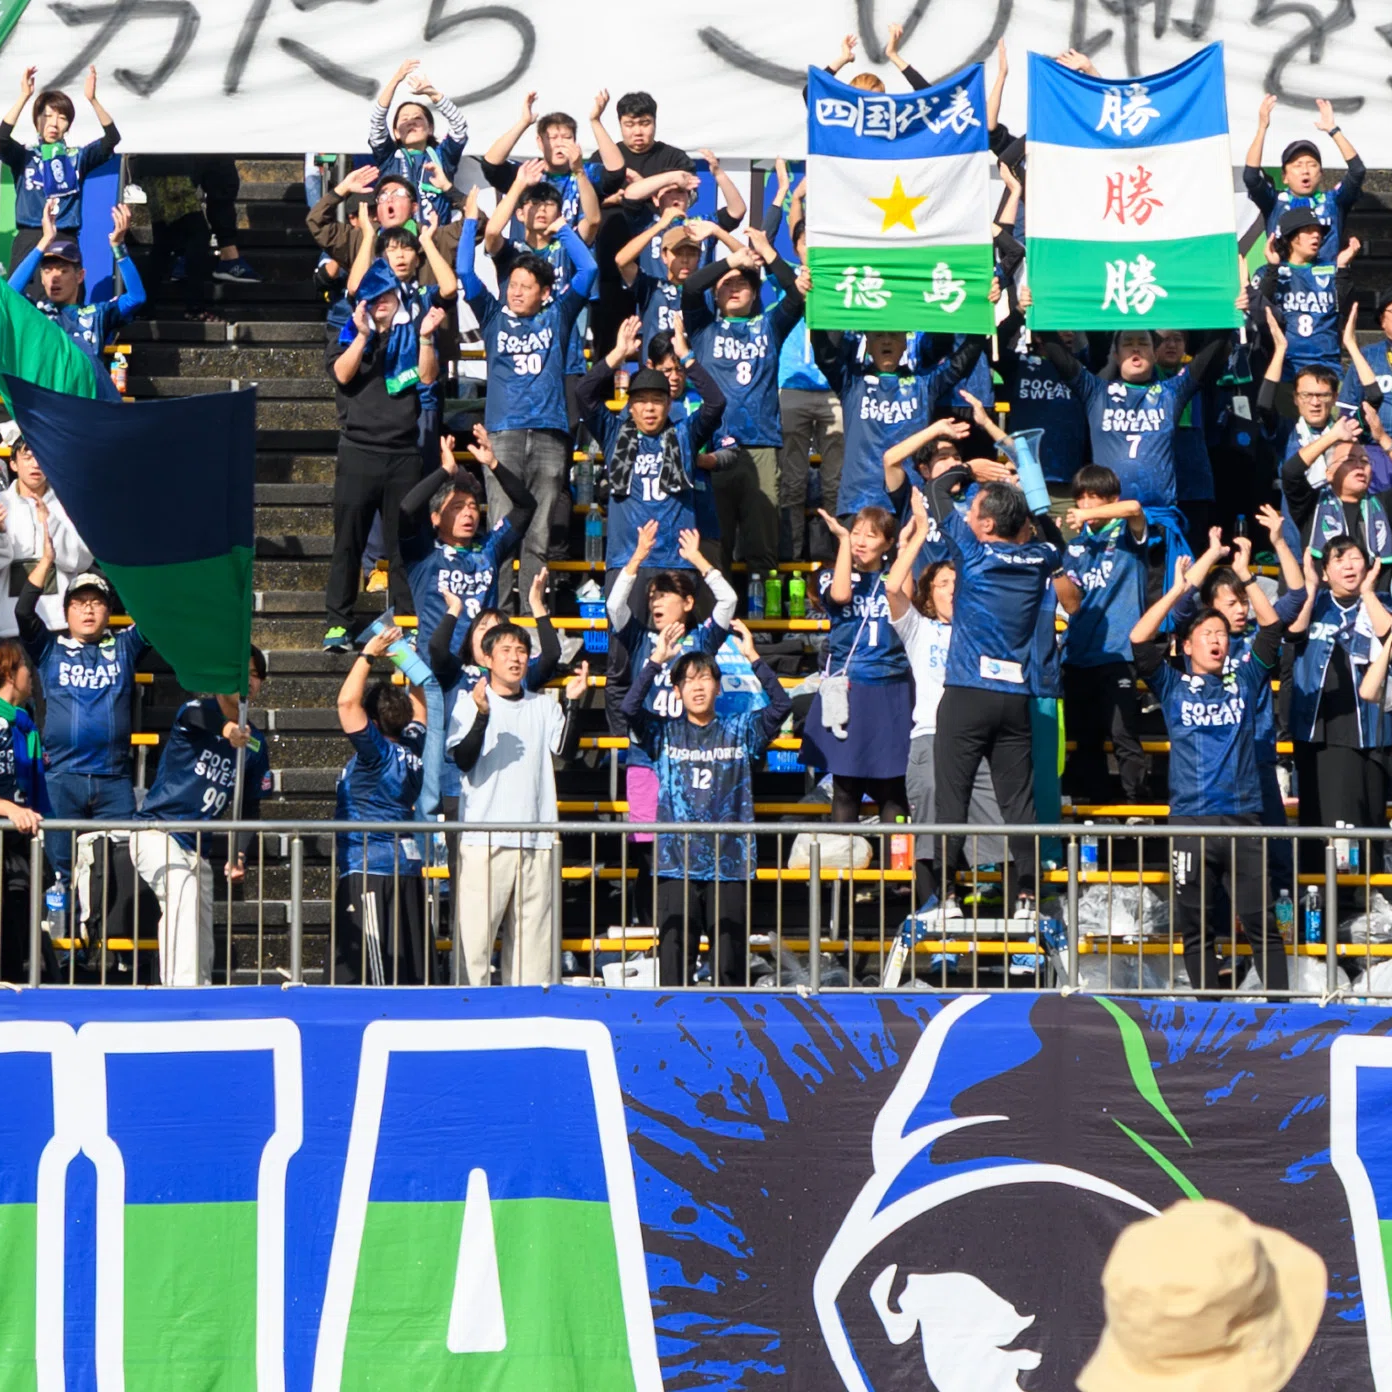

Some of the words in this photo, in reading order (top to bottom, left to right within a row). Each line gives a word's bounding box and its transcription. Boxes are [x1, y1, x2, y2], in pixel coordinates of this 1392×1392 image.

[815, 84, 982, 142] 四国代表
[1095, 82, 1161, 138] 勝
[1102, 163, 1165, 227] 勝
[835, 261, 968, 315] 徳島
[1101, 252, 1169, 315] 勝
[1297, 314, 1314, 337] 8
[512, 353, 543, 375] 30
[735, 361, 753, 385] 8
[861, 395, 918, 412] POCARI
[1103, 407, 1166, 423] POCARI
[1101, 417, 1161, 434] SWEAT
[1125, 433, 1143, 459] 7
[464, 596, 482, 619] 8
[841, 604, 891, 619] SWEA
[867, 620, 879, 647] 1
[58, 671, 117, 690] SWEAT
[1180, 699, 1246, 715] POCARI
[1180, 712, 1243, 727] SWEAT
[690, 767, 713, 790] 12
[201, 786, 230, 816] 99
